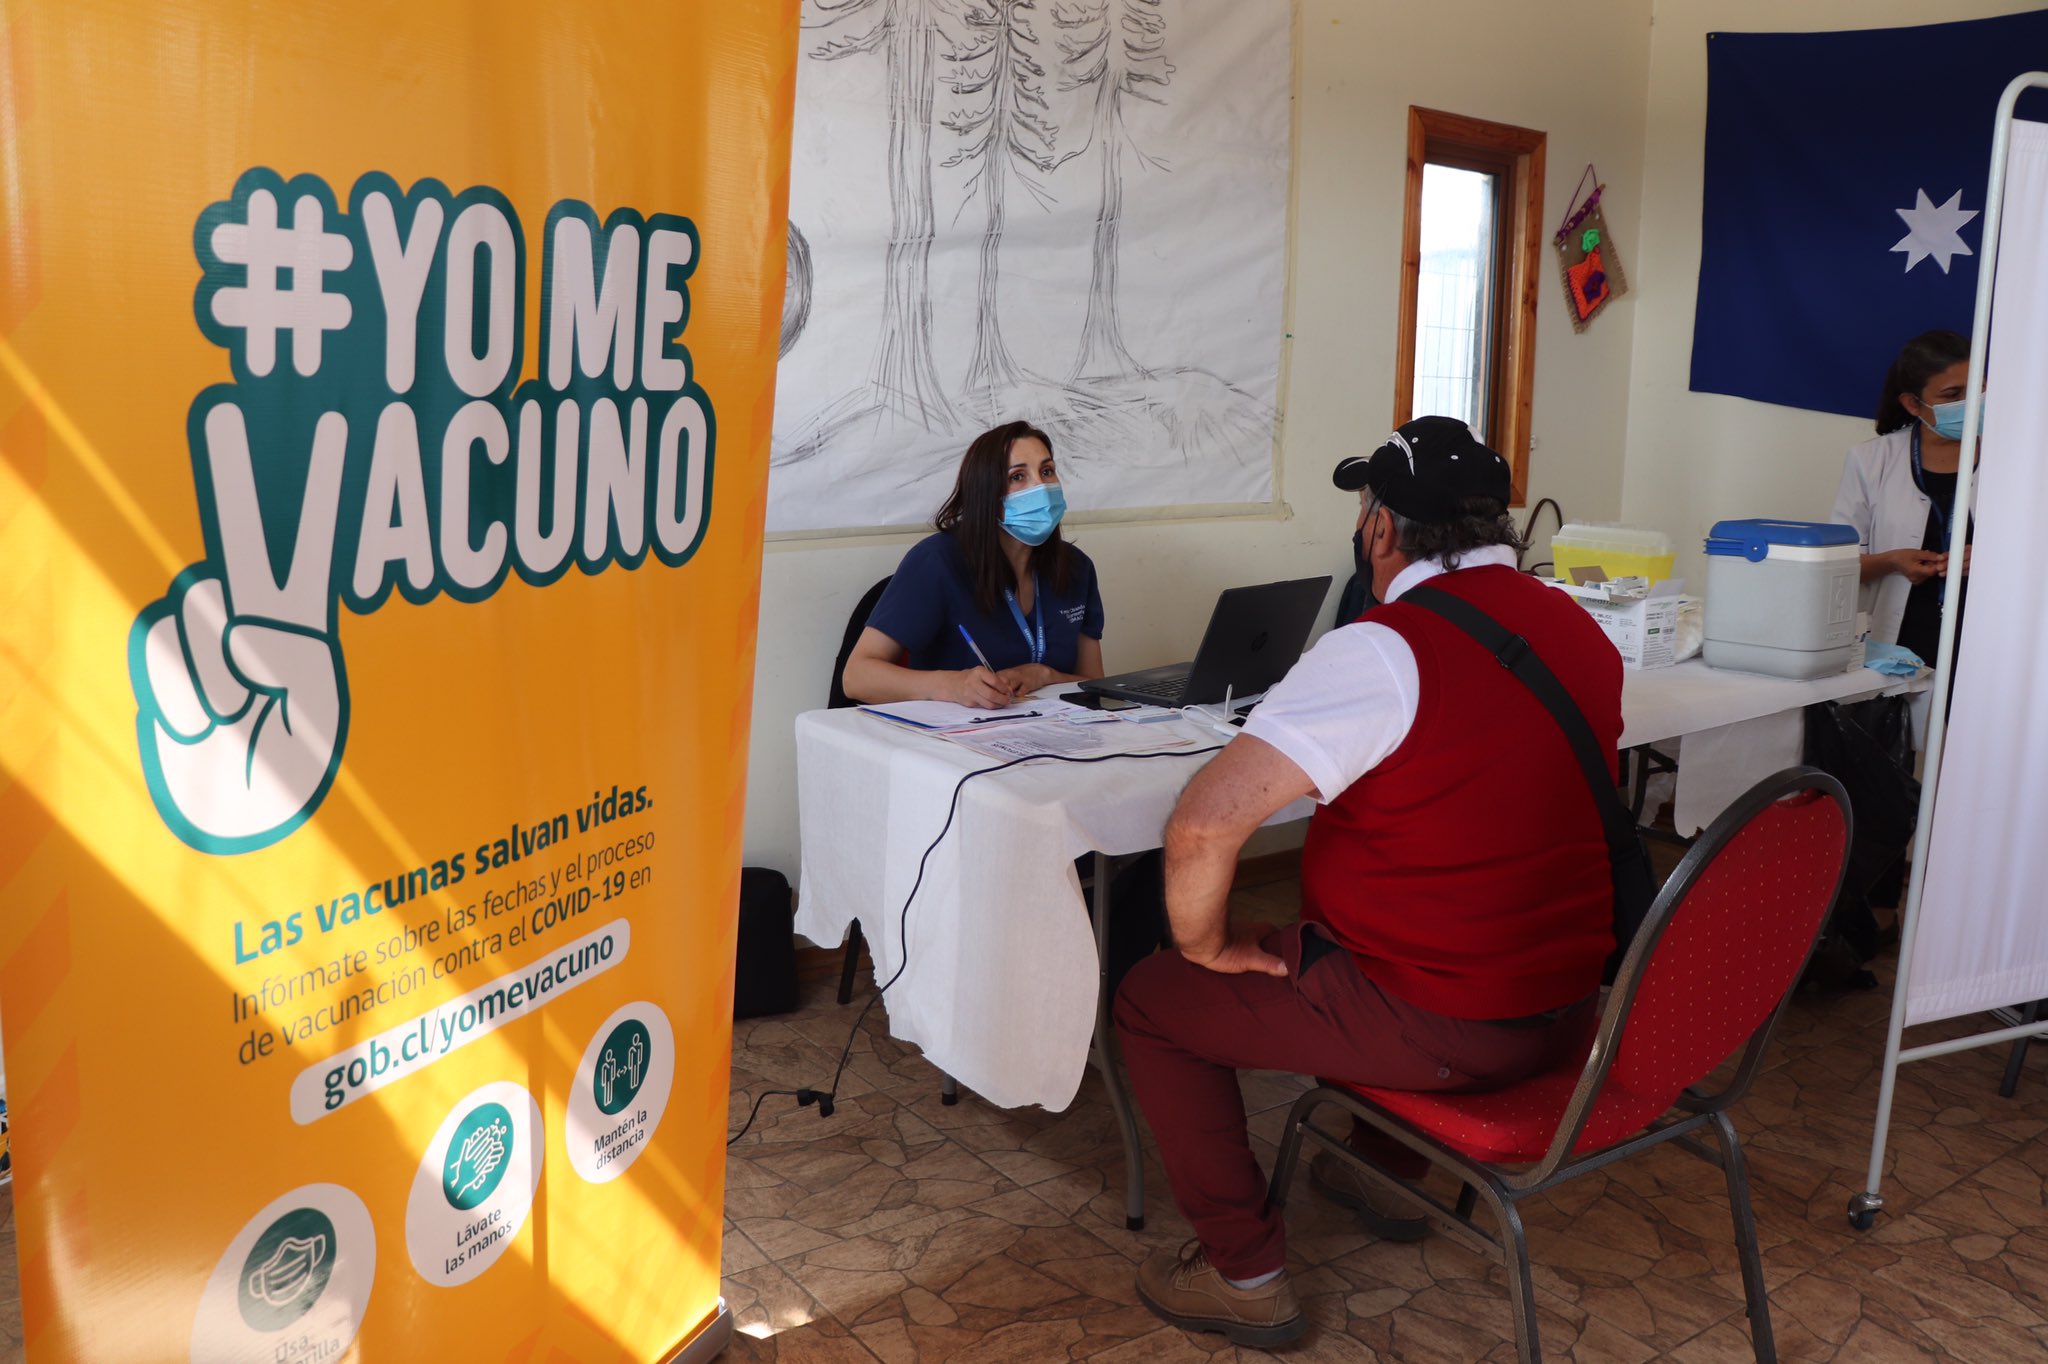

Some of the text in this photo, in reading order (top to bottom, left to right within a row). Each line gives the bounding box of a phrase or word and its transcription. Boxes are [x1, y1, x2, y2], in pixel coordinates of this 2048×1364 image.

[210, 188, 693, 398] #YO ME
[204, 395, 708, 625] VACUNO
[232, 831, 655, 1024] Infórmate sobre las fechas y el proceso
[233, 785, 654, 966] Las vacunas salvan vidas.
[238, 864, 652, 1067] de vacunación contra el COVID-19 en
[323, 933, 614, 1110] gob.cl/yomevacuno
[594, 1109, 648, 1154] Mantén la
[596, 1128, 645, 1170] distancia
[445, 1220, 512, 1275] las manos
[456, 1208, 502, 1247] Lávate
[274, 1334, 310, 1363] Usa
